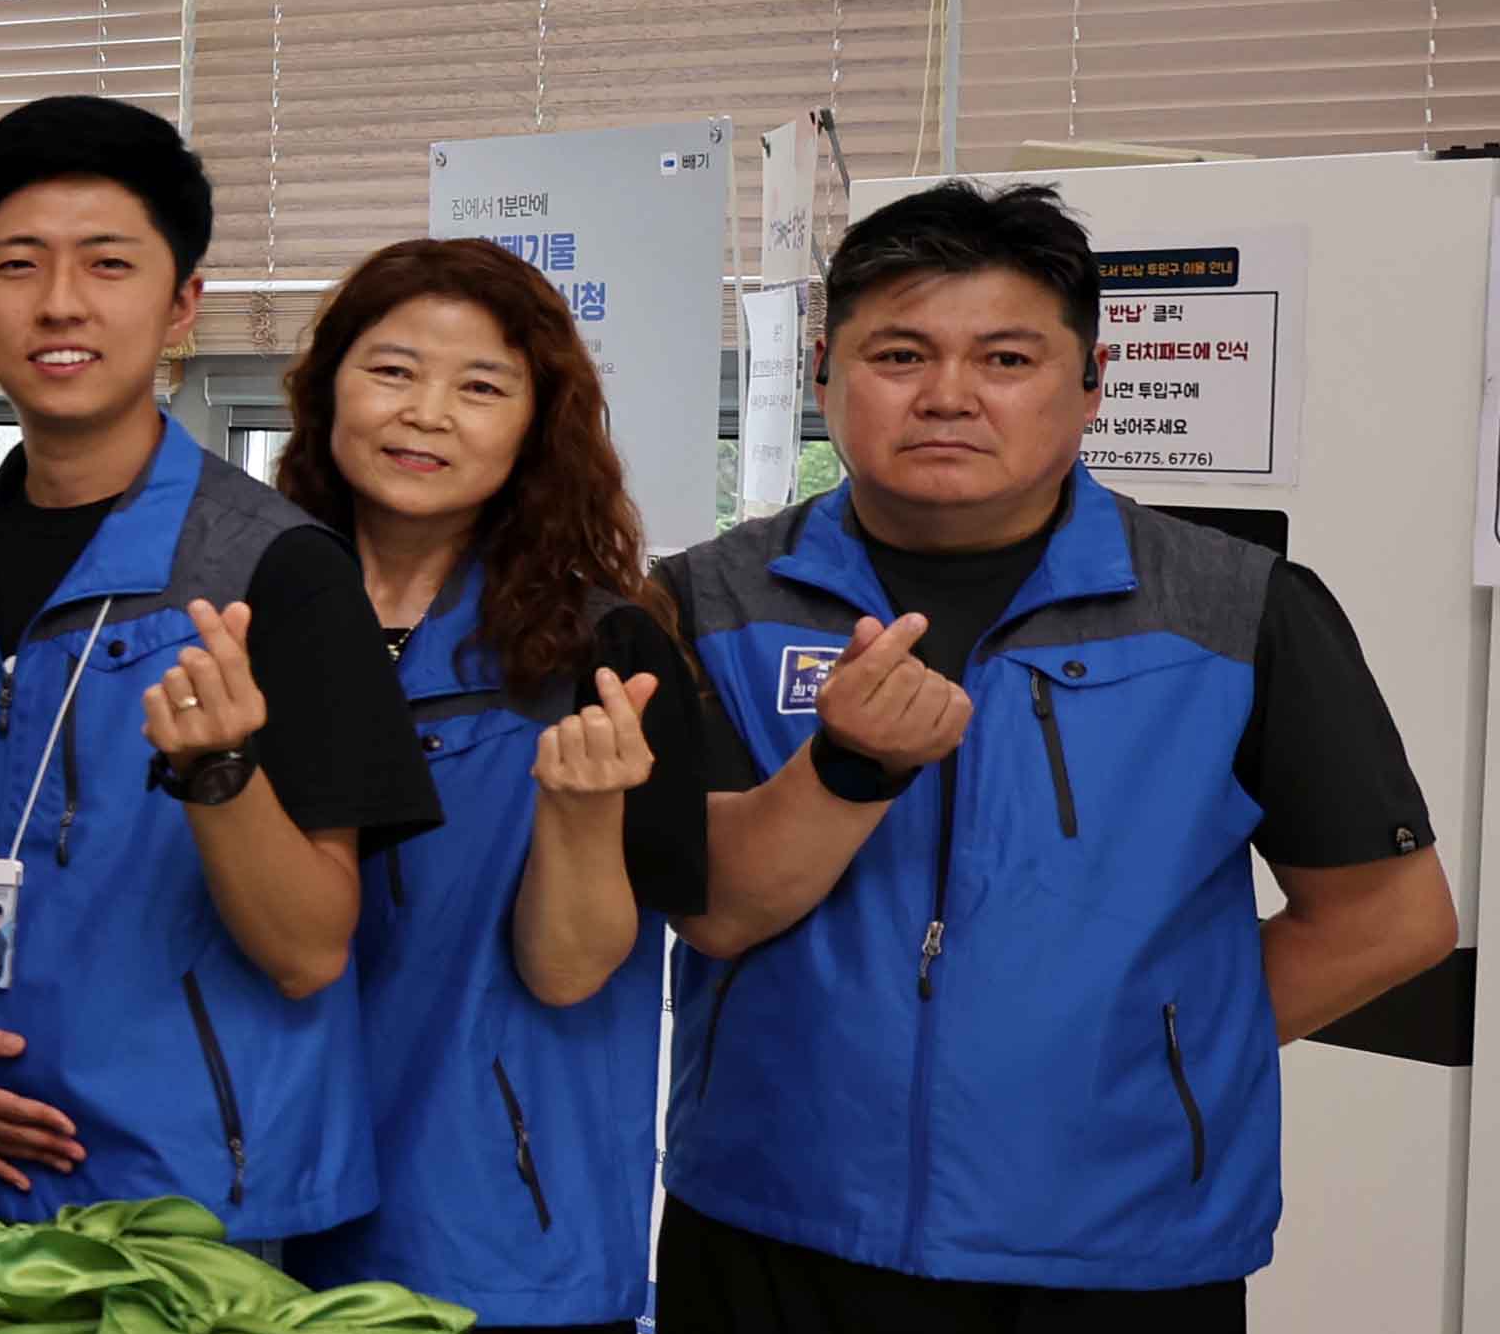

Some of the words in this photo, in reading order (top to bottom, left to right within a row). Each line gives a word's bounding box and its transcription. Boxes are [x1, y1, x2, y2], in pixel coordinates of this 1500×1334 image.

[451, 196, 494, 221] 집에서
[497, 192, 549, 219] 1분만에
[1152, 304, 1184, 323] 클릭
[1126, 341, 1211, 361] 터치패드에
[1216, 340, 1249, 362] 인식
[1138, 381, 1200, 399] 투입구에
[1113, 418, 1188, 436] 넣어주세요
[1168, 451, 1213, 467] 6776)
